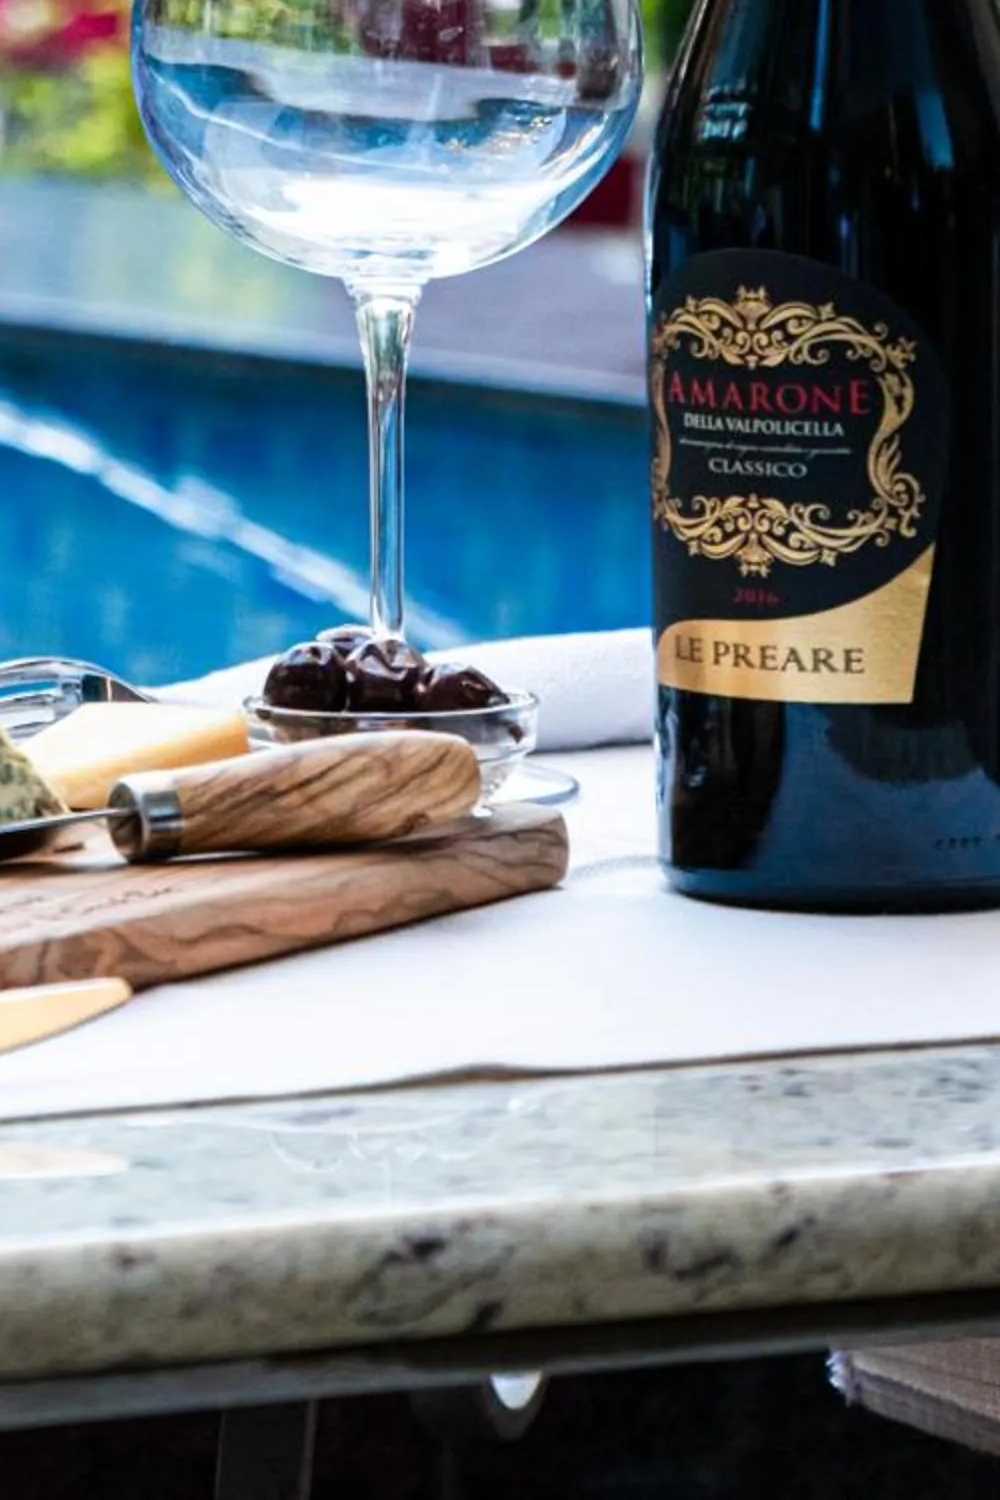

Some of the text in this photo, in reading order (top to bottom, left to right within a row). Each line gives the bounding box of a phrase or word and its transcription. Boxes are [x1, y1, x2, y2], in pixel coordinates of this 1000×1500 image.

[669, 371, 870, 416] AMARONE
[684, 412, 844, 437] DELLA VALPOLICELLA
[708, 457, 808, 479] CLASSICO
[674, 635, 866, 675] LE PREARE
